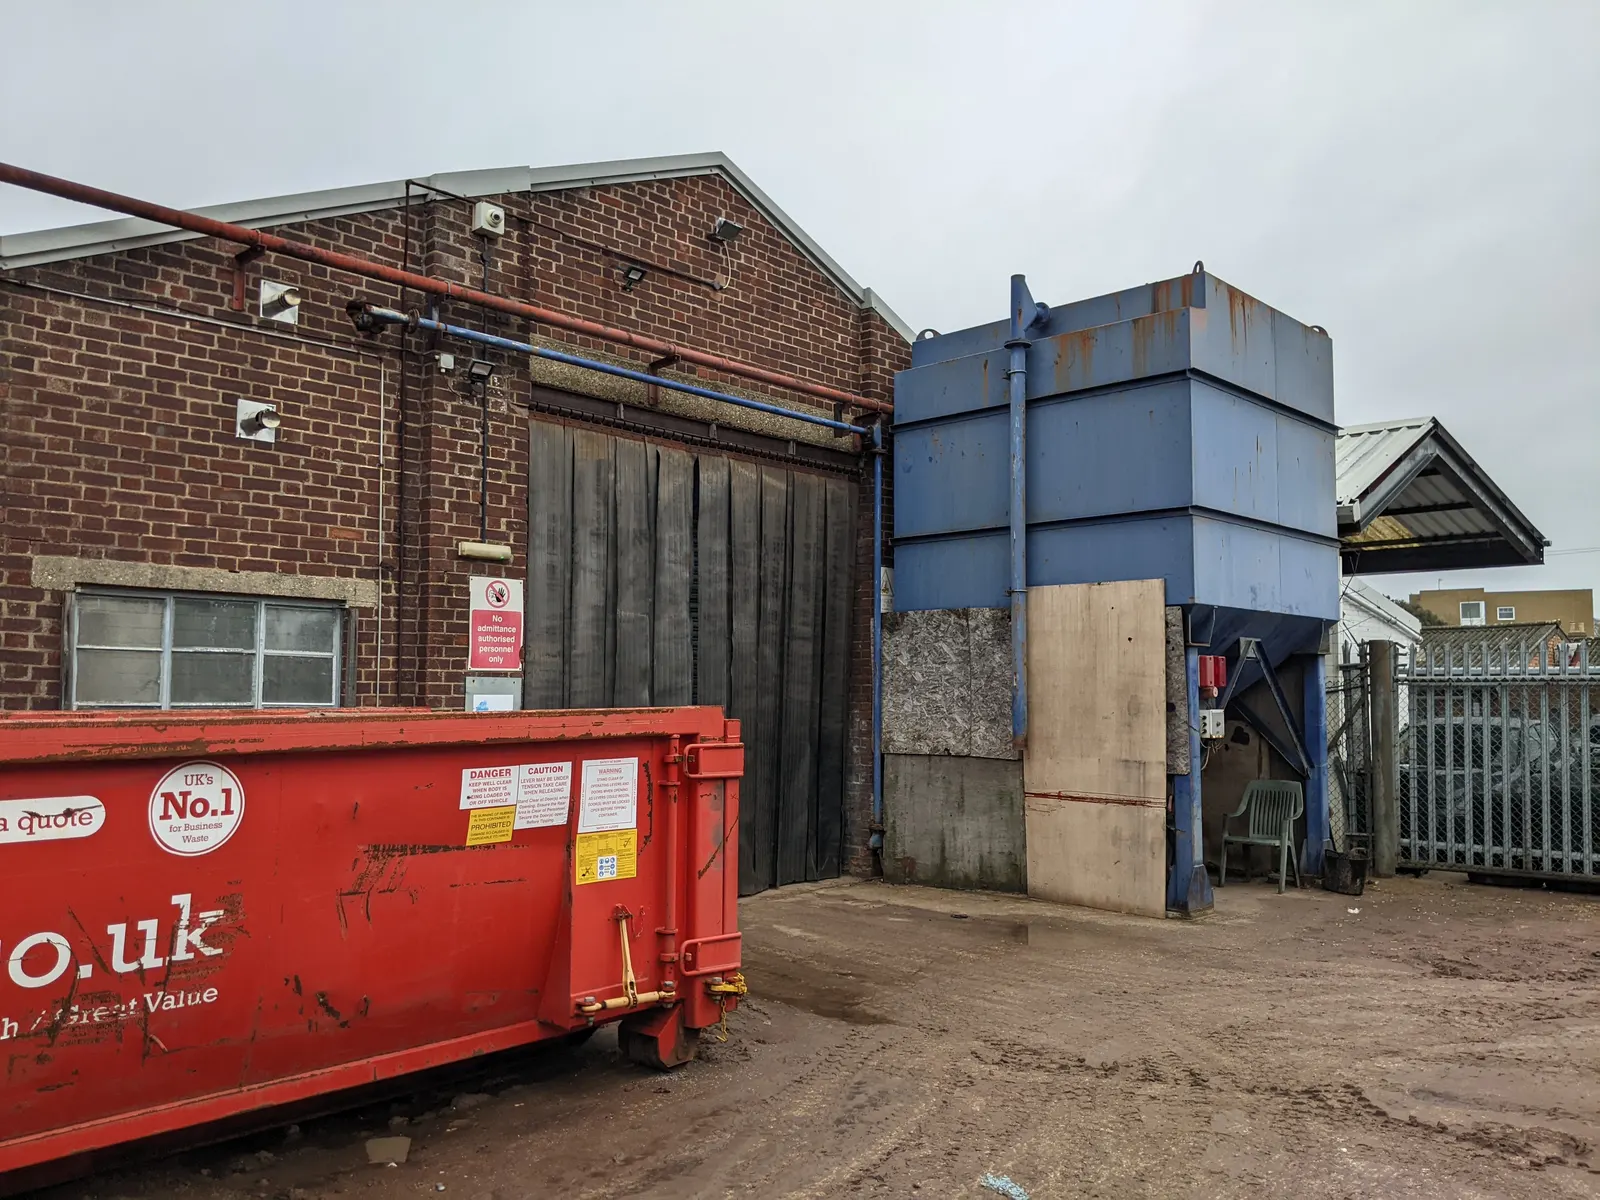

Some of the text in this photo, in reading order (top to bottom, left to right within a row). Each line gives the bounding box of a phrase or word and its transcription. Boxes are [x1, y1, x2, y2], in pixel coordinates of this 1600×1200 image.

[478, 635, 515, 643] authorised
[479, 646, 514, 654] personnel
[489, 656, 504, 664] only
[471, 769, 511, 779] DANGER
[528, 766, 563, 774] CAUTION
[184, 773, 214, 786] UK's
[159, 788, 234, 820] No.1
[18, 810, 94, 836] quote
[169, 822, 223, 833] for Business
[471, 821, 511, 831] PROHIBITED
[182, 834, 209, 844] Waste
[0, 893, 224, 988] o.uk
[144, 986, 219, 1013] Value
